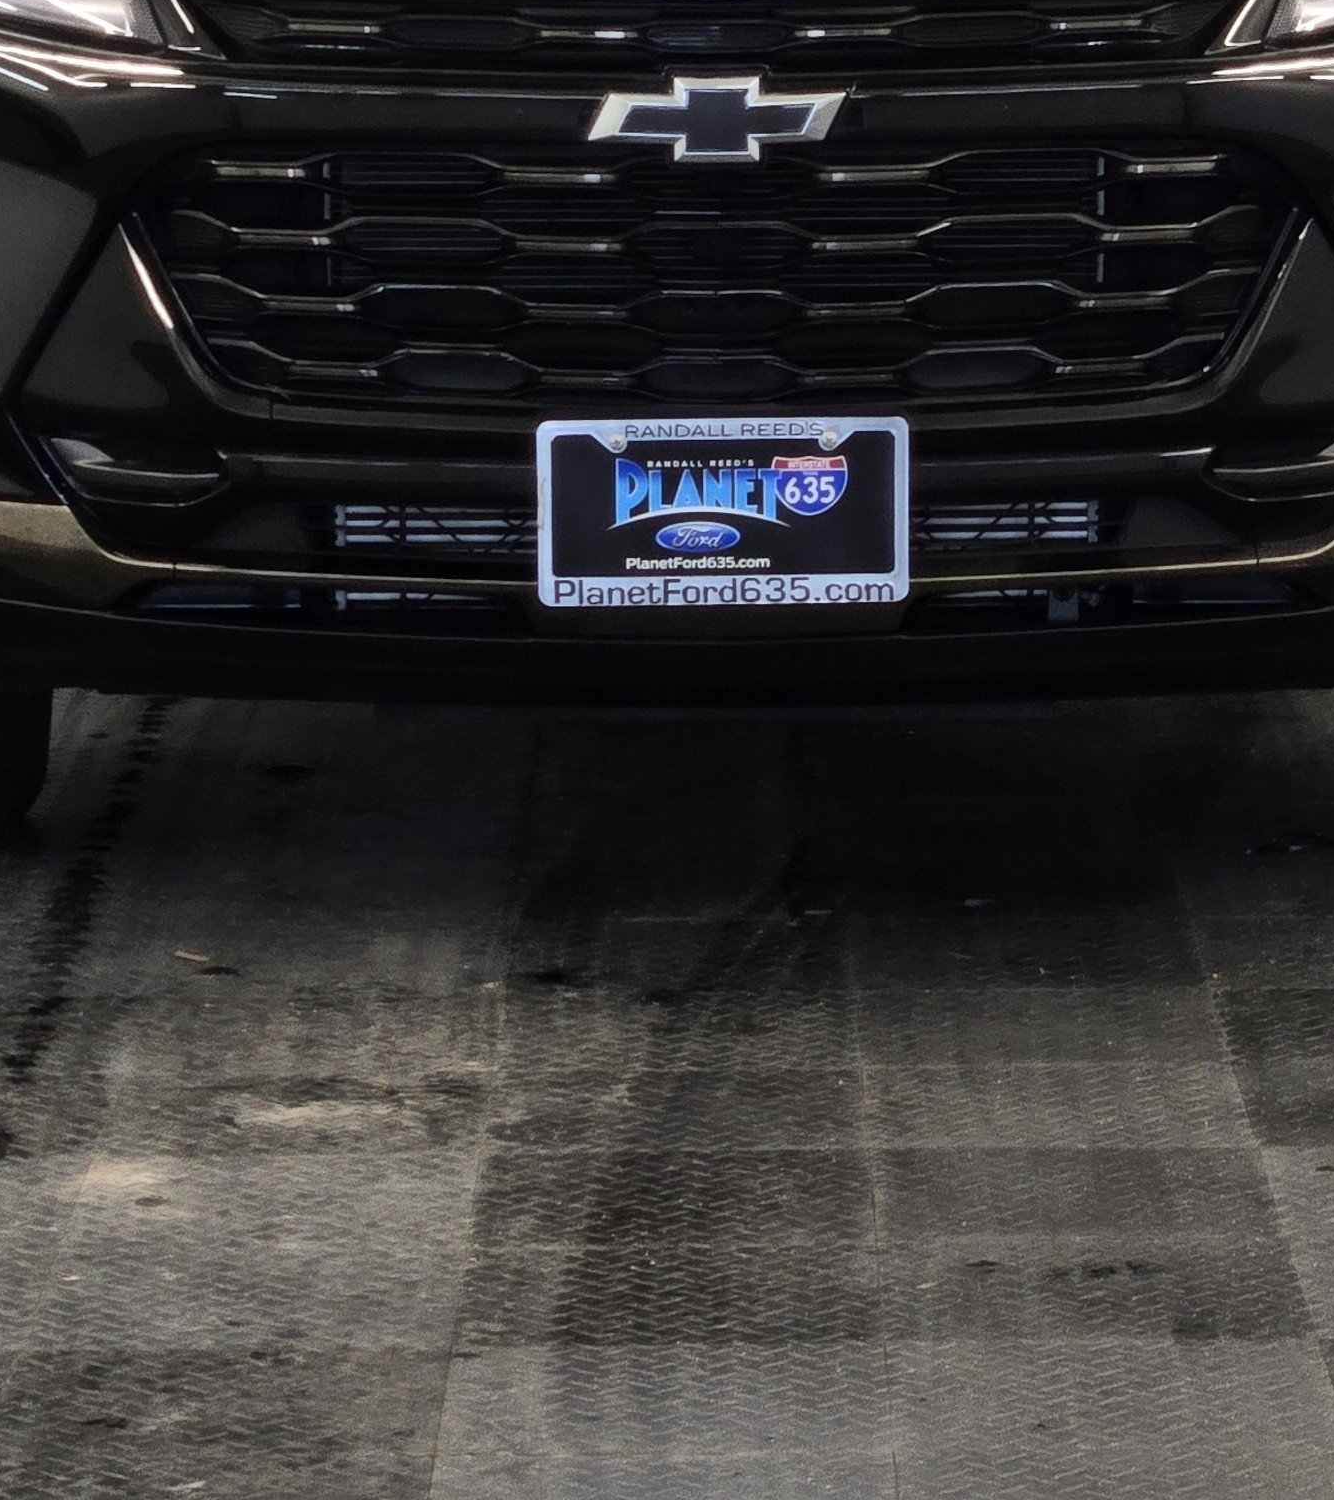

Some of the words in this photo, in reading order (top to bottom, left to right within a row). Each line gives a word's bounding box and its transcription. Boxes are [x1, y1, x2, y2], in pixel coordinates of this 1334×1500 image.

[624, 424, 733, 439] RANDALL
[740, 422, 825, 437] REED'S
[647, 460, 703, 468] RANDALL
[710, 459, 755, 468] REED'S
[615, 457, 783, 527] PLANET
[784, 476, 836, 505] 635
[672, 524, 724, 548] Ford
[625, 555, 771, 570] PlanetFord635.com
[553, 576, 895, 606] PlanetFord635.com
